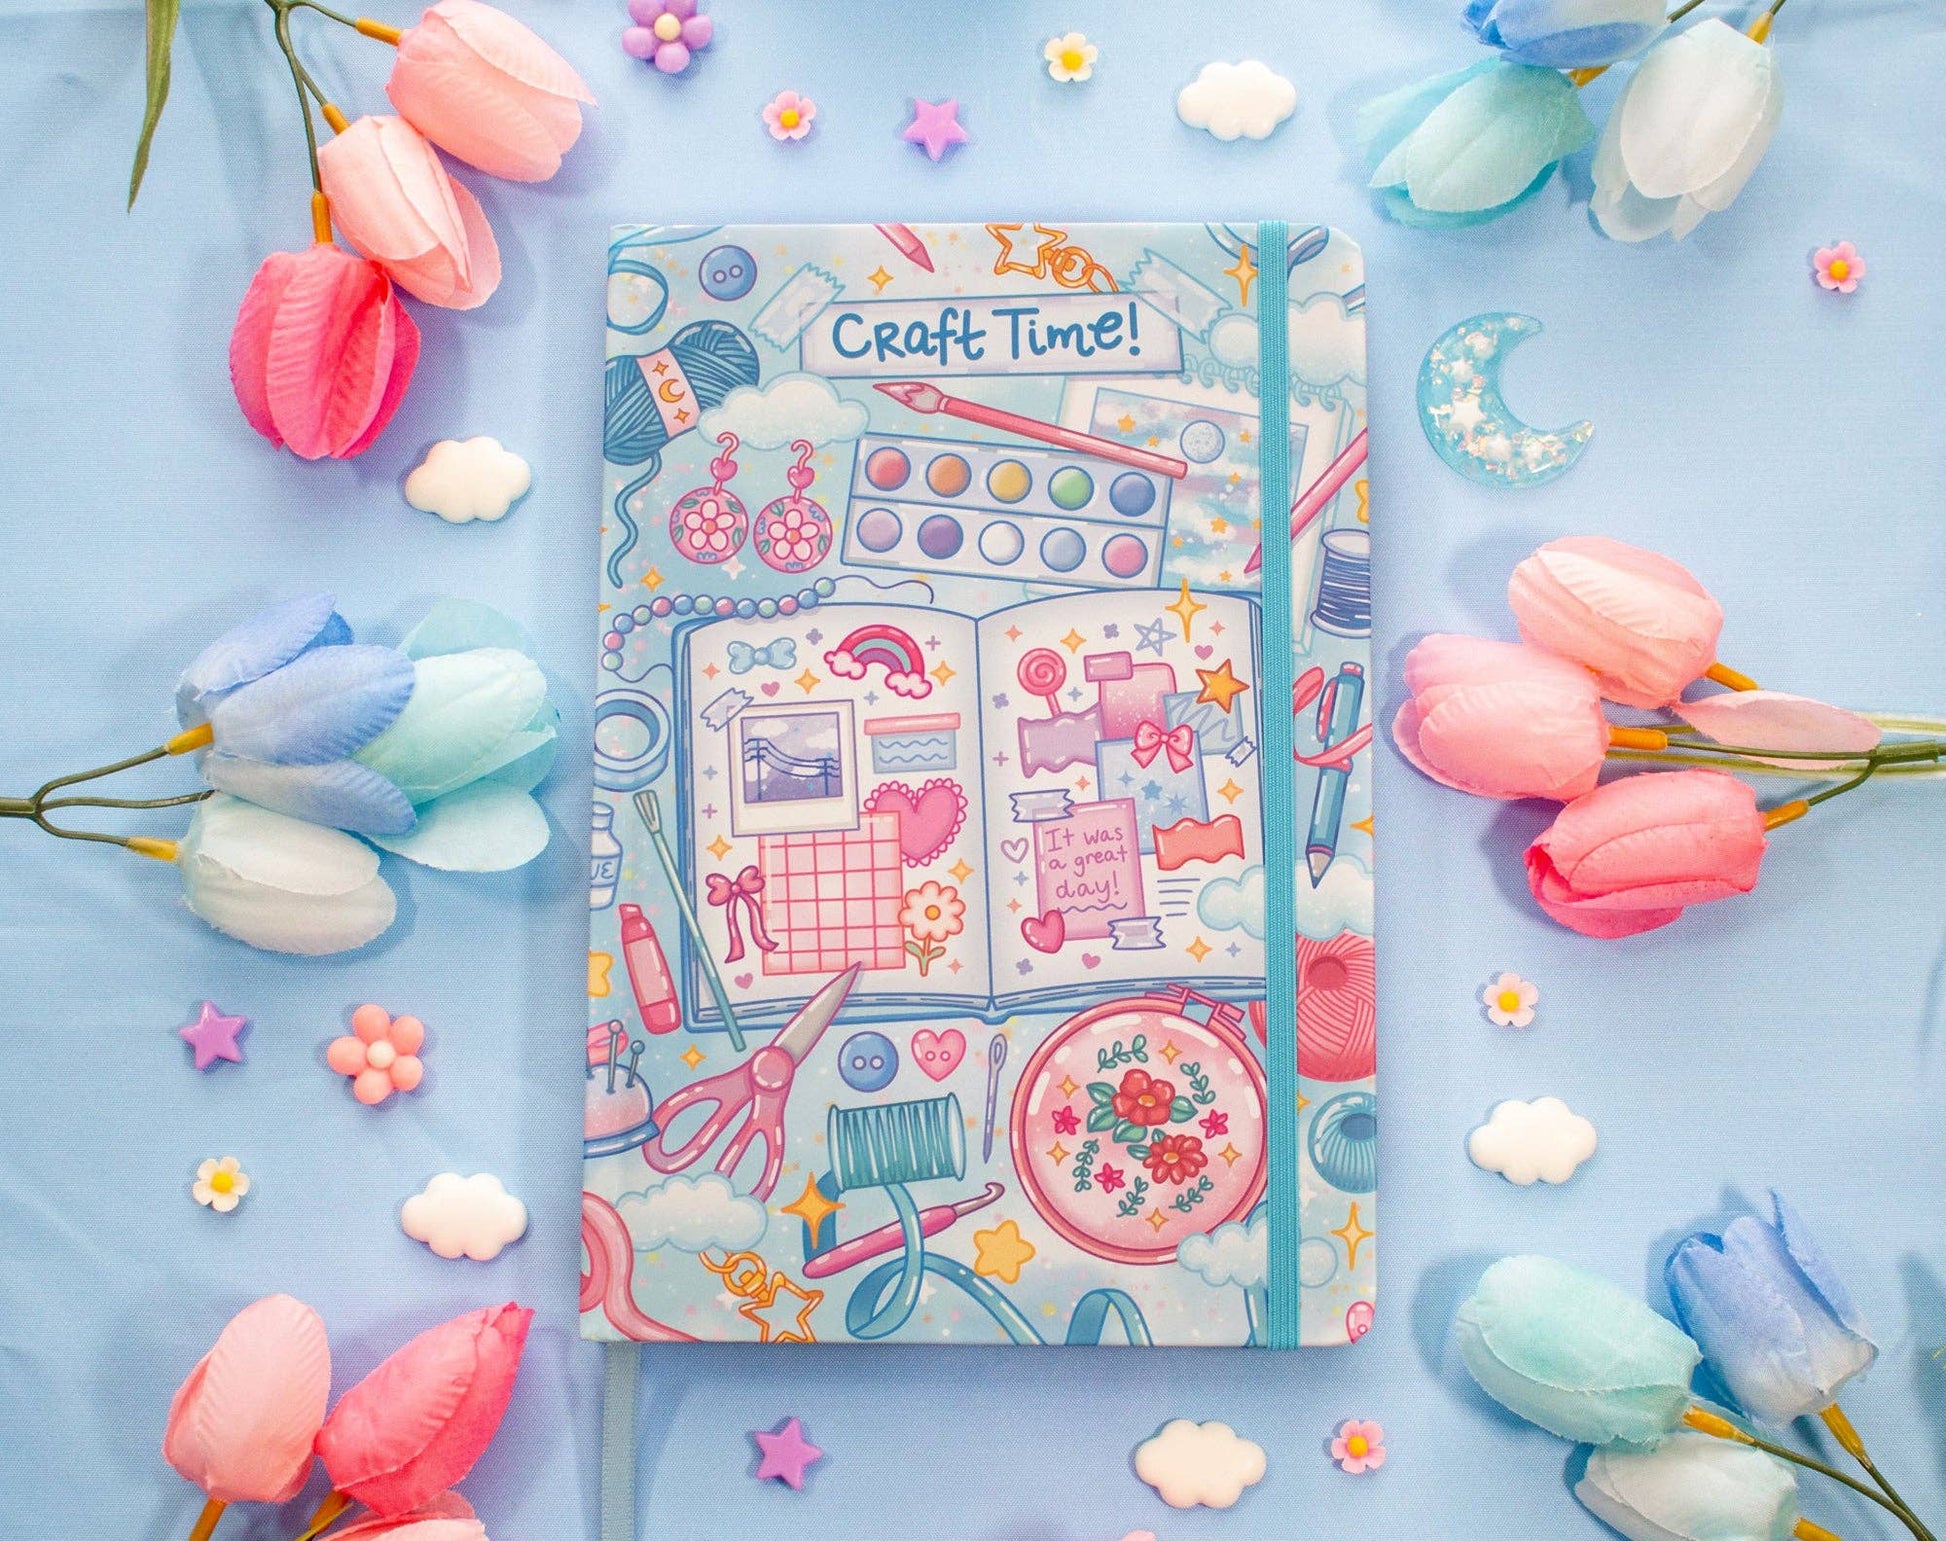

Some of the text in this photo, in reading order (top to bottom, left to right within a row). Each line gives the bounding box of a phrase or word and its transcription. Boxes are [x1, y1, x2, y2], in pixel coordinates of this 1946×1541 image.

[991, 301, 1141, 360] Time!
[1045, 827, 1124, 852] It was
[1048, 844, 1128, 878] a great
[1056, 870, 1120, 904] day!
